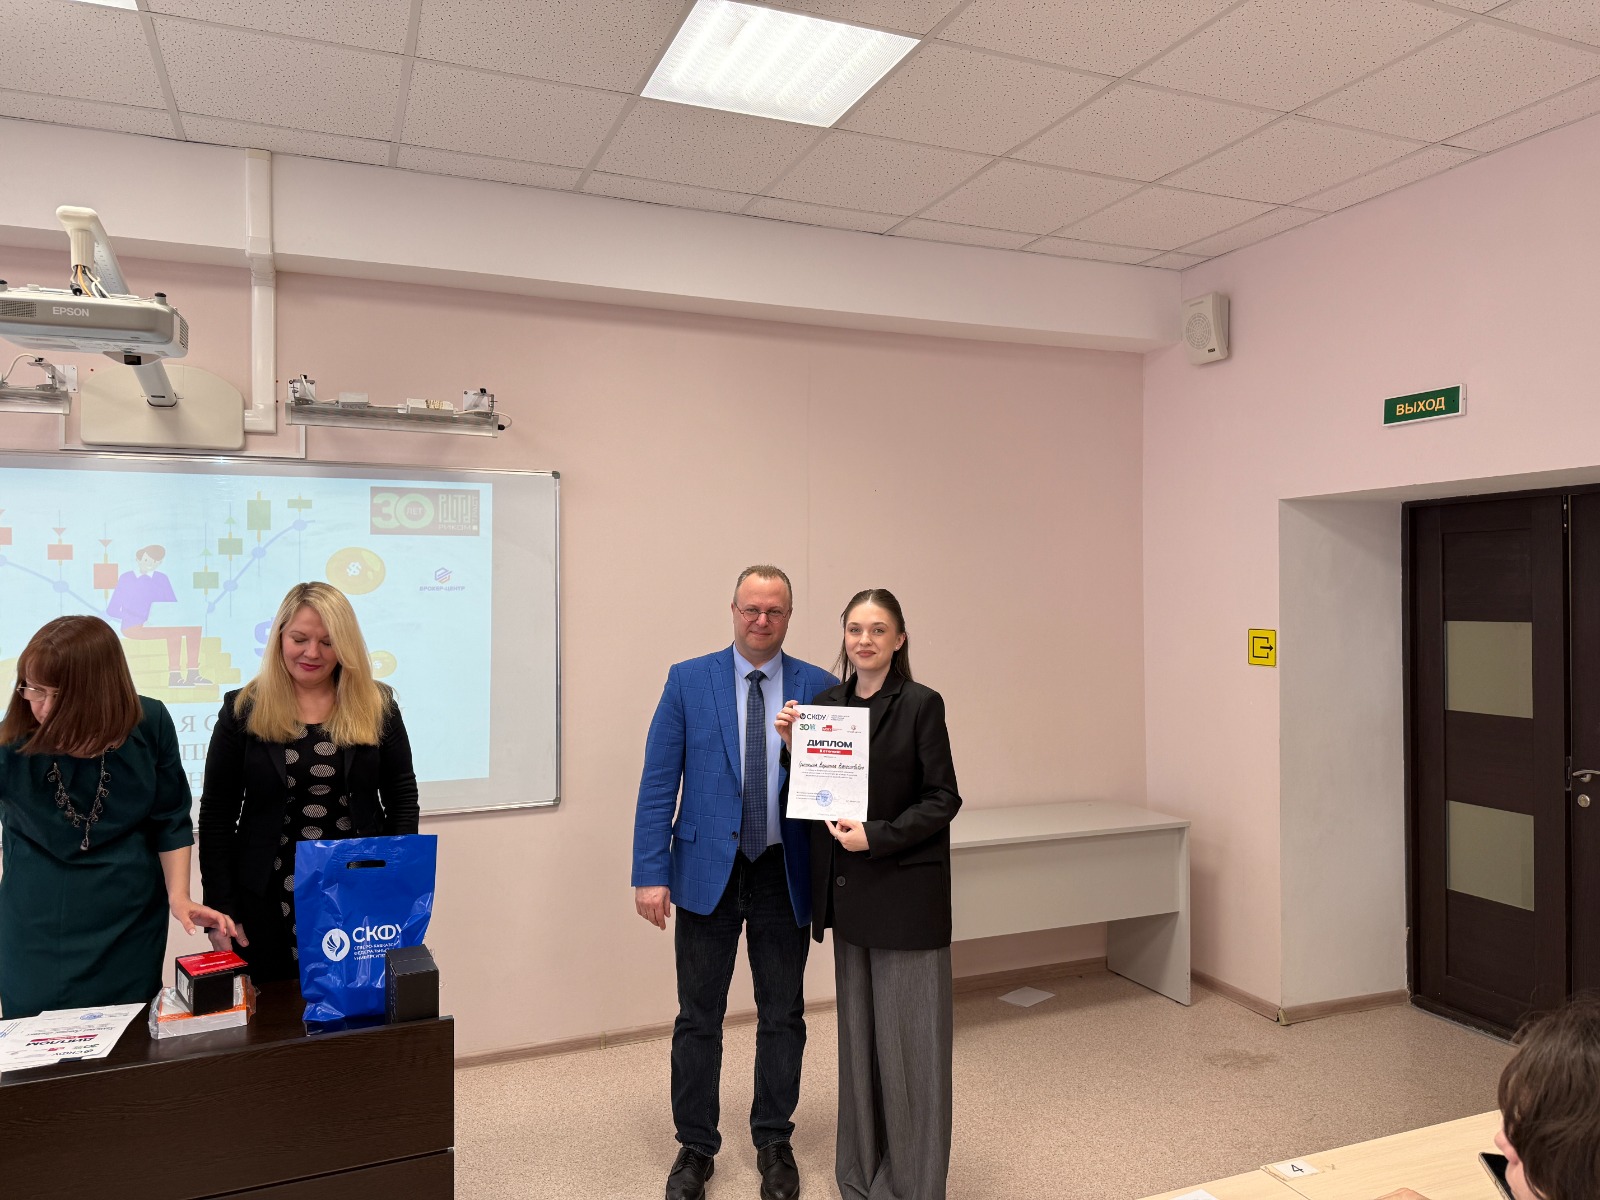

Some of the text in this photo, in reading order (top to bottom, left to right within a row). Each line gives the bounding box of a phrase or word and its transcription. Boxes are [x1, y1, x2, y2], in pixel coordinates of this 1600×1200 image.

[52, 306, 89, 317] EPSON
[1396, 397, 1445, 416] ВЫХОД
[371, 492, 435, 529] 30
[406, 507, 424, 516] ЛЕТ
[807, 740, 853, 749] ДИПЛОМ
[353, 953, 387, 961] УНИВЕРСИТЕ
[1290, 1164, 1305, 1173] 4
